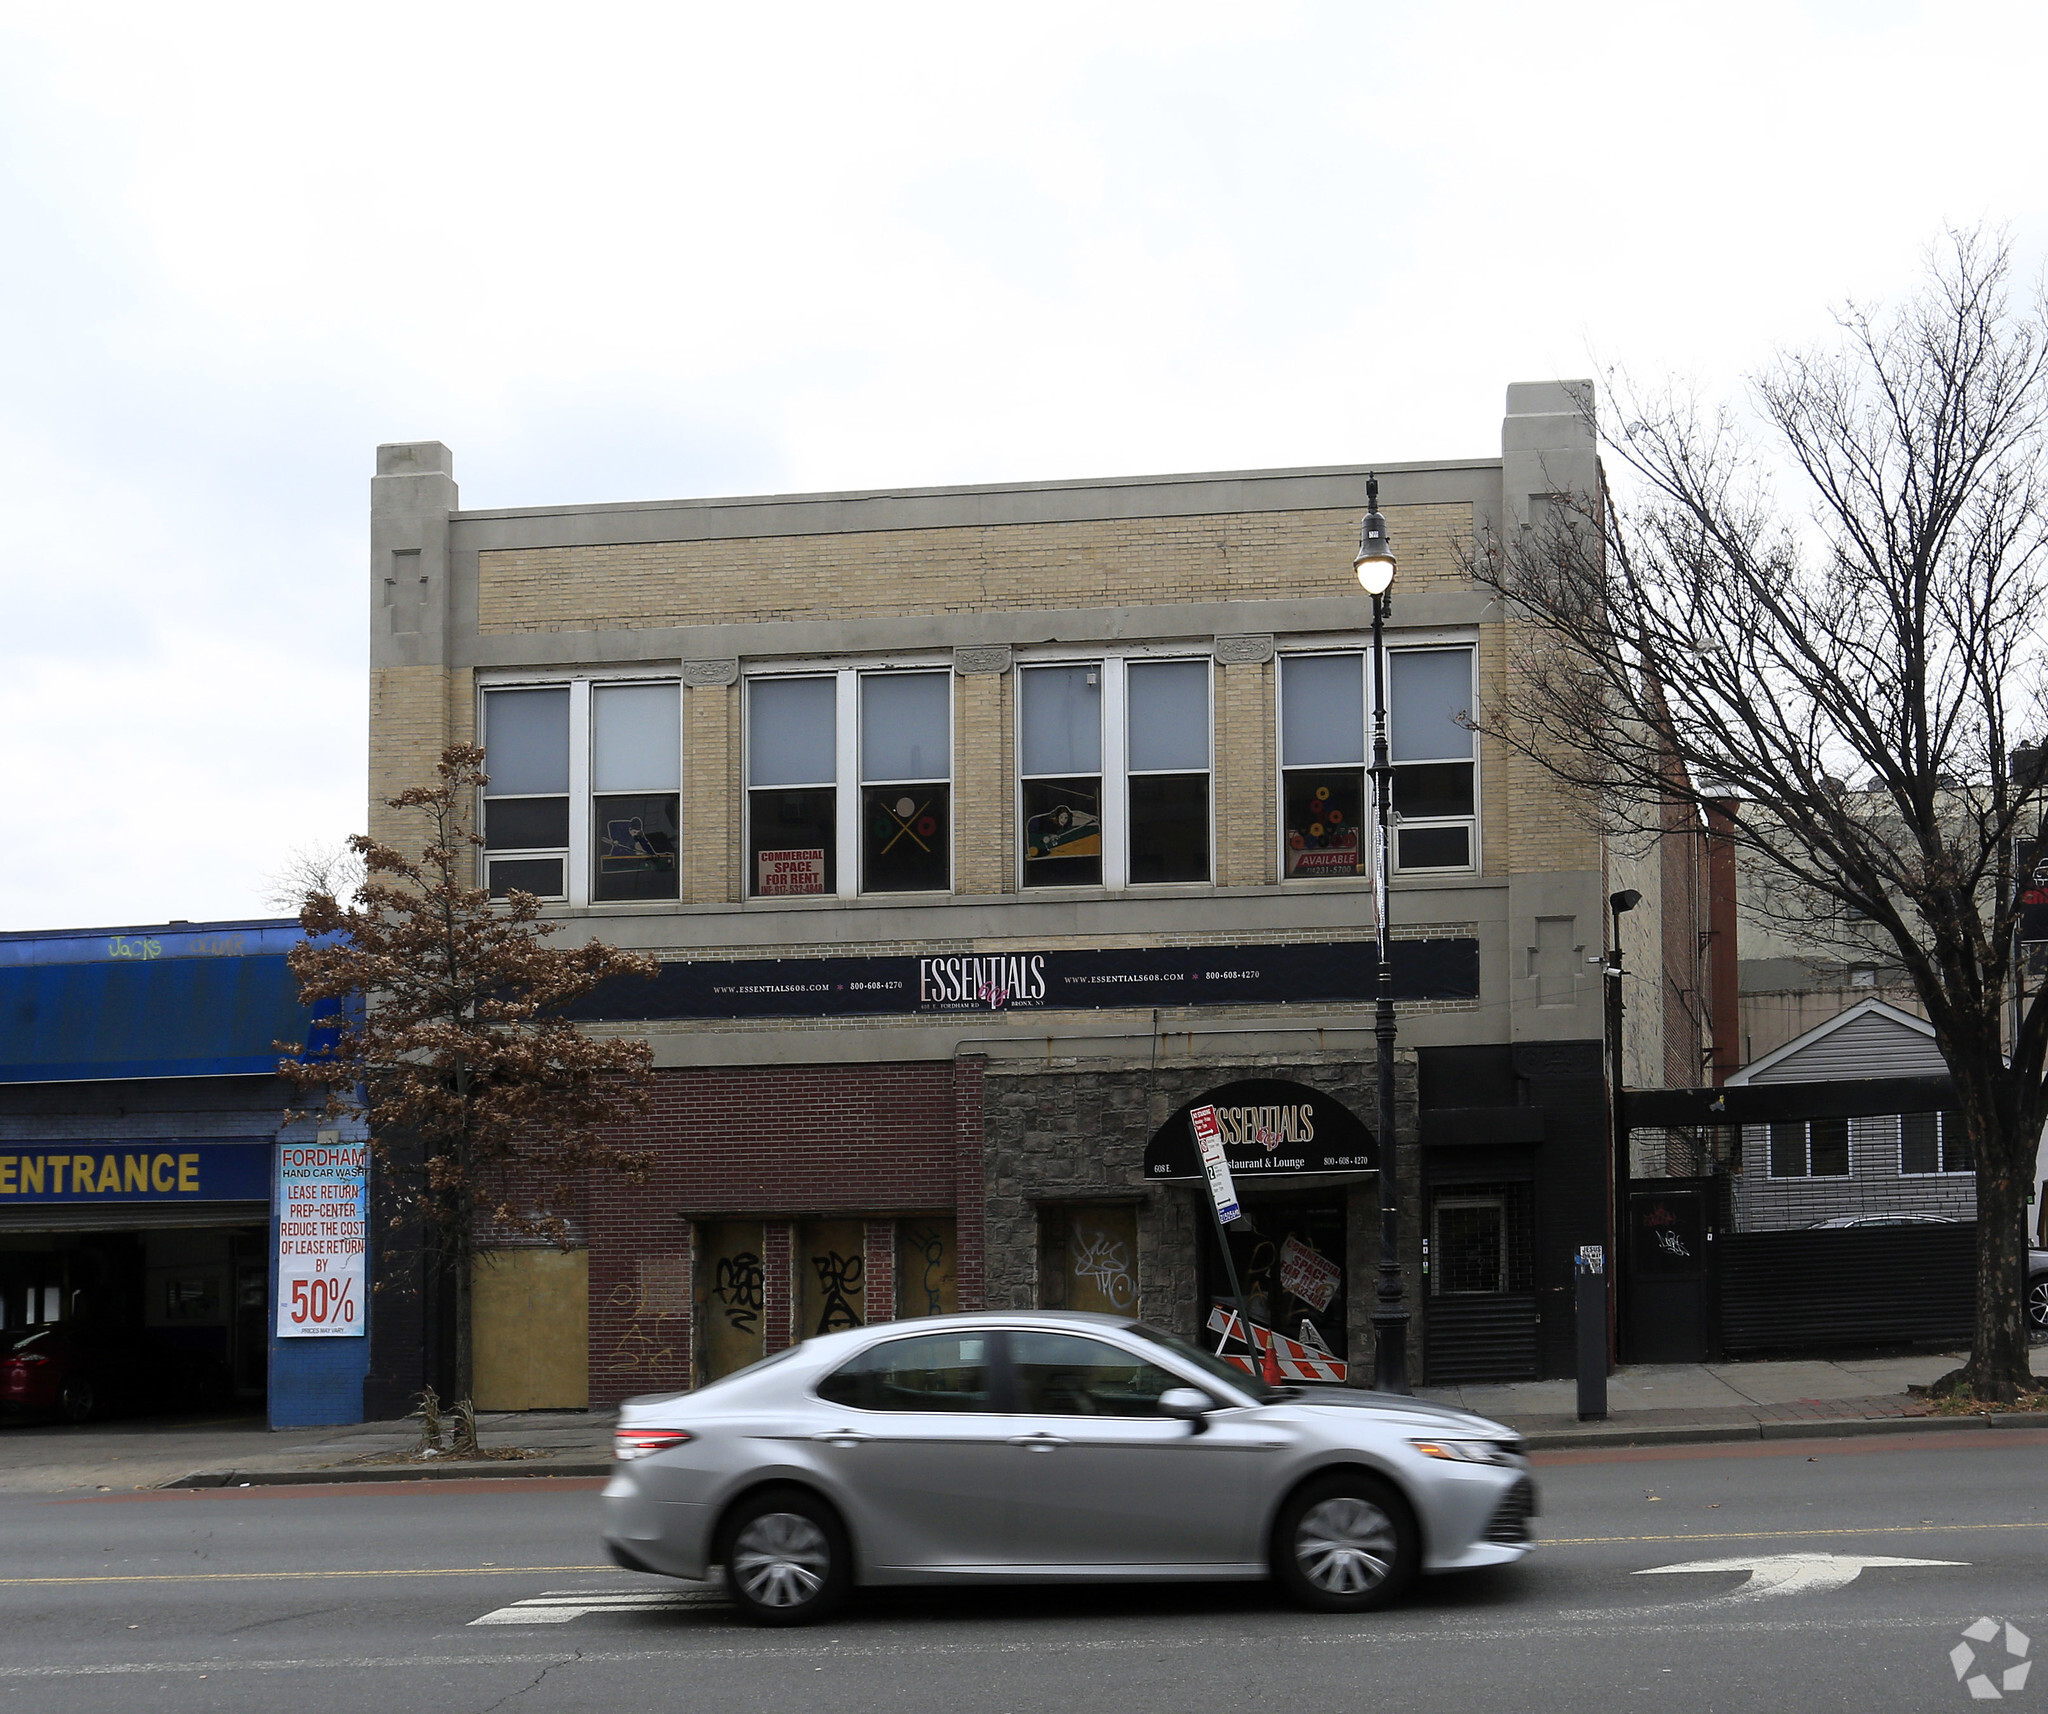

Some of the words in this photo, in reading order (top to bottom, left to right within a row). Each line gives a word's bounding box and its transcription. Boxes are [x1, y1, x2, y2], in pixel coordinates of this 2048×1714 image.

[761, 850, 823, 862] COMMERCIAL
[1301, 854, 1355, 865] AVAILABLE
[774, 861, 812, 873] SPACE
[1315, 866, 1352, 874] 231-5700
[766, 874, 788, 885] FOR
[790, 873, 819, 884] RENT
[920, 955, 1046, 1010] ESSENTIALS
[1215, 1104, 1314, 1151] SSENTIALS
[282, 1148, 365, 1167] FORDHAM
[1264, 1157, 1272, 1168] &
[1273, 1156, 1305, 1170] Lounge
[0, 1153, 200, 1194] ENTRANCE
[282, 1169, 311, 1178] HAND
[312, 1168, 333, 1178] CAR
[335, 1168, 365, 1177] WASH
[1154, 1164, 1166, 1173] 608
[1166, 1163, 1172, 1172] E.
[288, 1185, 317, 1200] LEASE
[320, 1184, 359, 1199] RETURN
[290, 1203, 356, 1218] PREP-CENTER
[281, 1221, 318, 1236] REDUCE
[320, 1221, 338, 1236] THE
[340, 1221, 365, 1236] COST
[281, 1240, 294, 1255] OF
[295, 1240, 325, 1255] LEASE
[326, 1239, 364, 1254] RETURN
[315, 1258, 328, 1273] BY
[1293, 1255, 1328, 1284] SPACE
[291, 1277, 353, 1324] 50%
